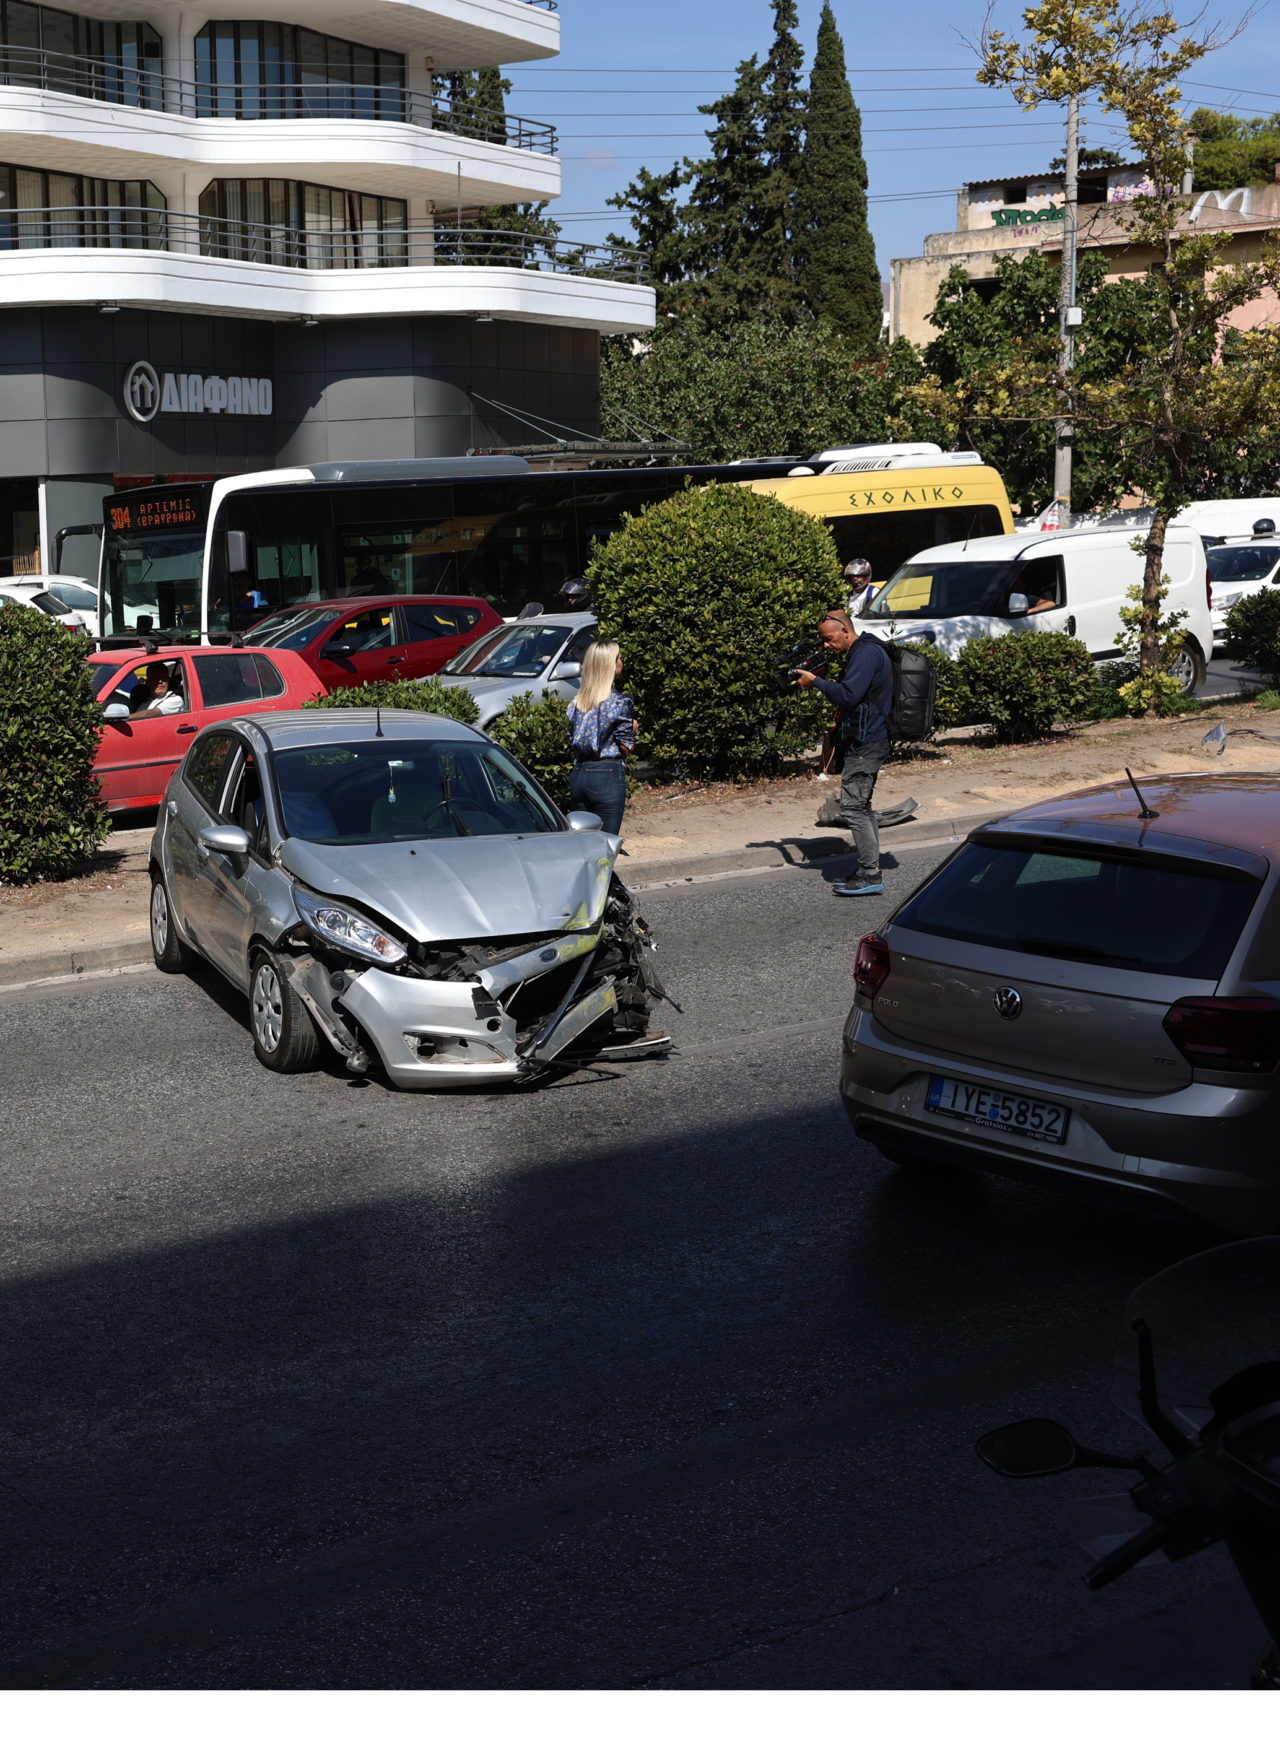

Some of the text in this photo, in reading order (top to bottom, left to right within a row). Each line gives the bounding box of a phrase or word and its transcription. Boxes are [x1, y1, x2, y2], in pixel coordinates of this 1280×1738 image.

[160, 373, 272, 415] ΔΙΑΦΑΝΟ
[849, 486, 963, 507] ΣΧΟΛΙΚΟ
[110, 498, 191, 529] 304 ΑΡΤΕΜΙΣ
